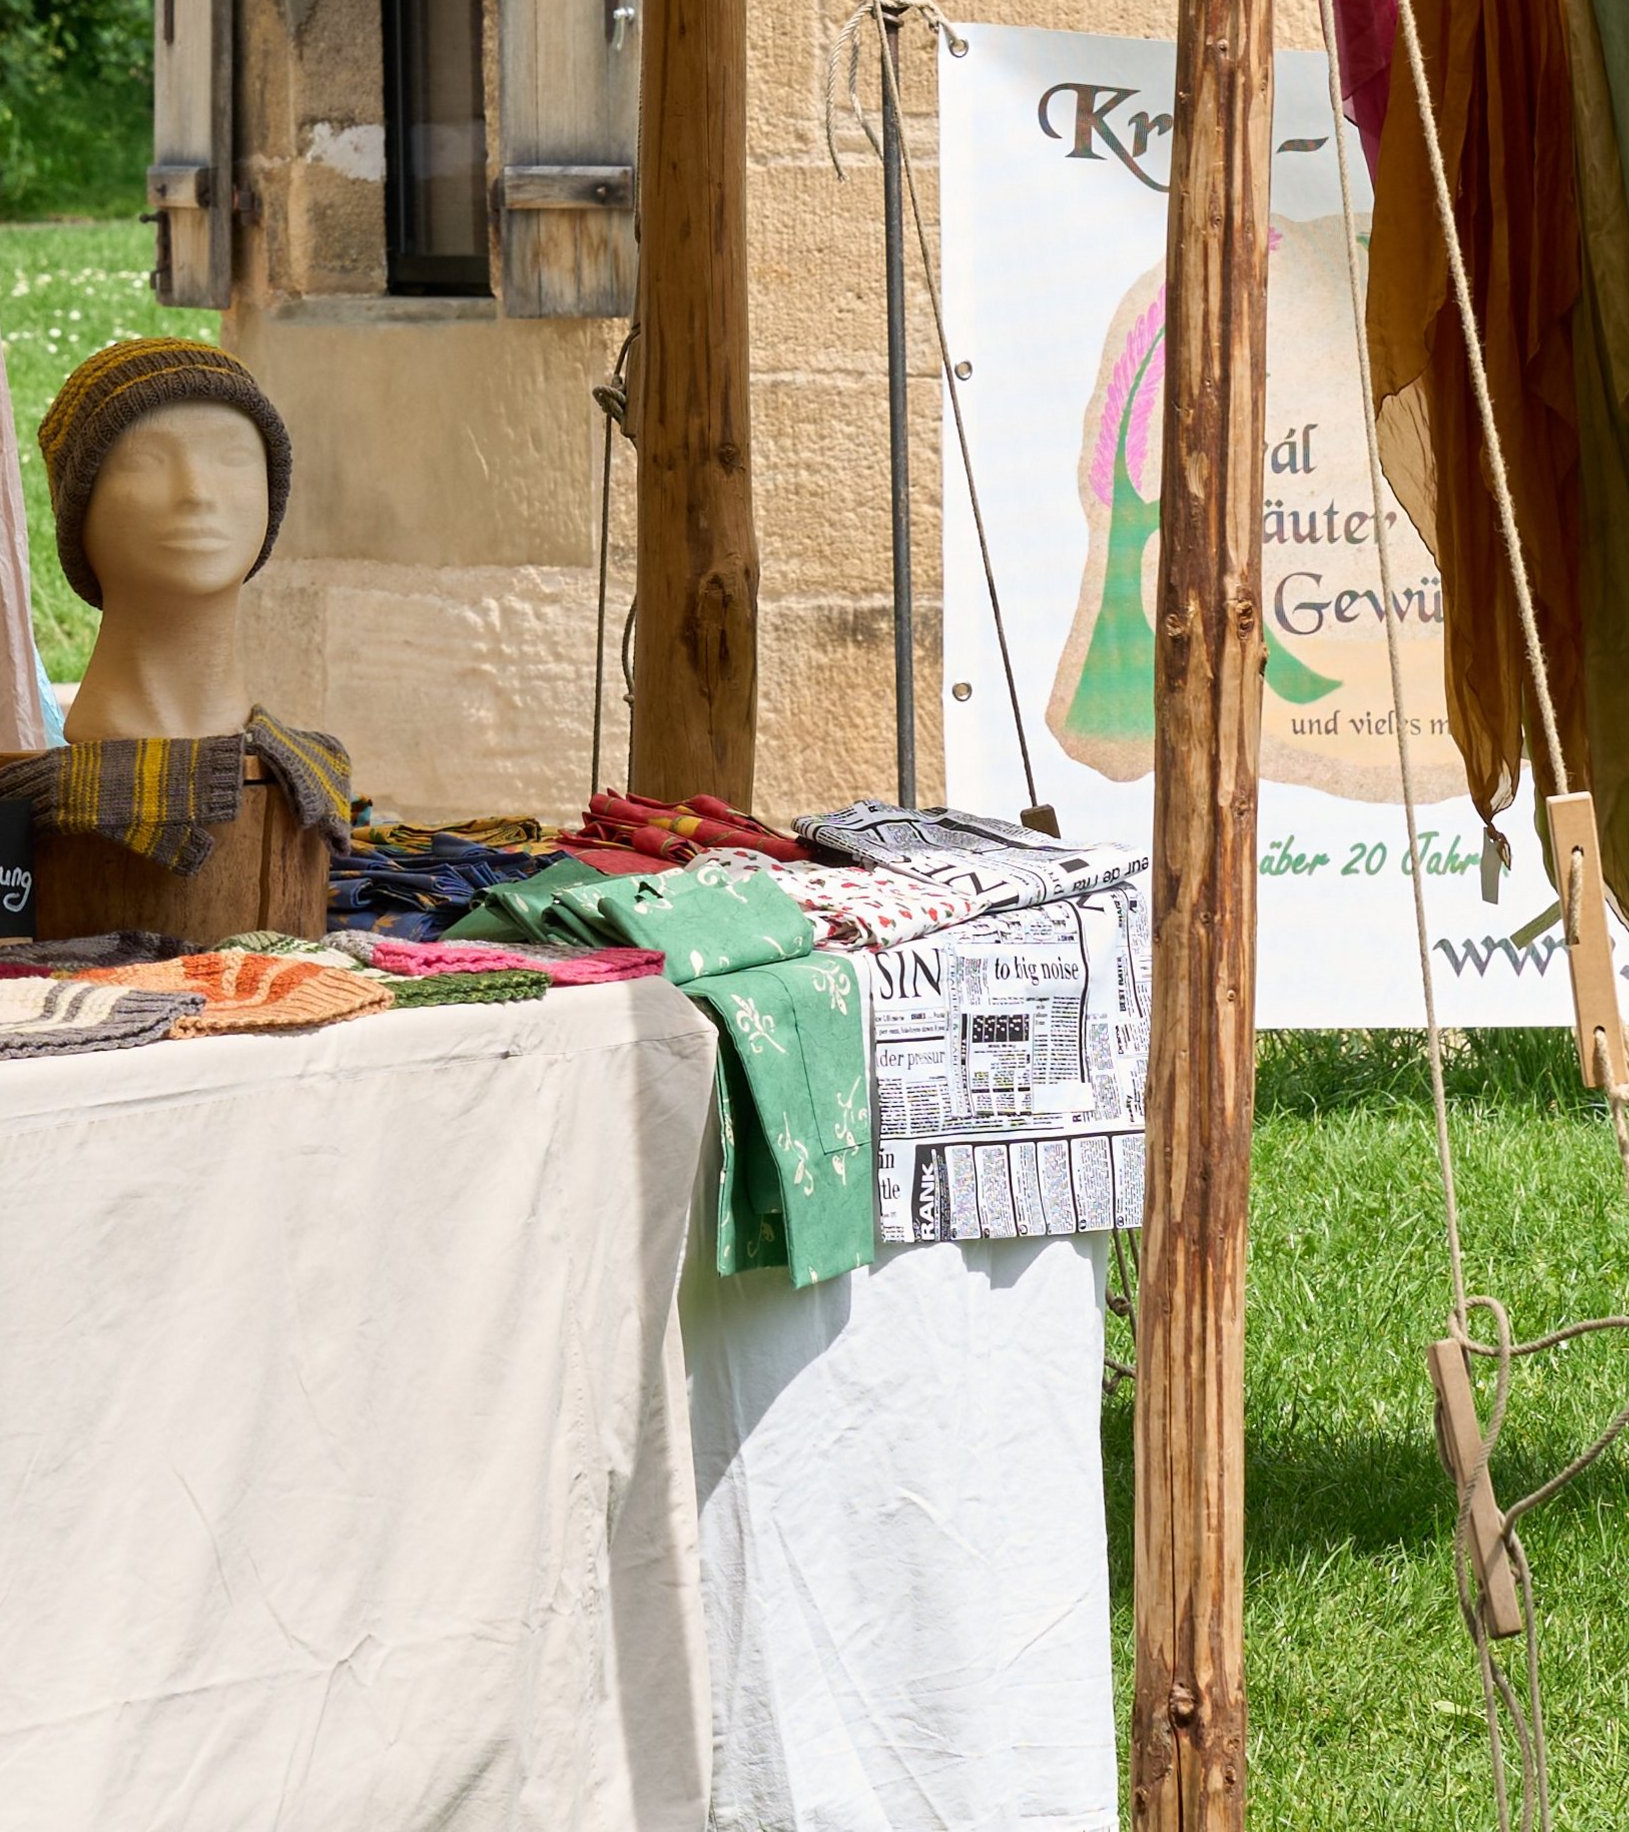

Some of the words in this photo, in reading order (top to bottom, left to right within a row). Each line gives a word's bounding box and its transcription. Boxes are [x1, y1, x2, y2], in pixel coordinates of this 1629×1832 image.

[1038, 82, 1174, 193] Kr
[1262, 423, 1319, 475] ál
[1262, 497, 1397, 545] äuter
[1274, 571, 1444, 635] Gewü
[1291, 710, 1342, 736] und
[1340, 841, 1388, 877] 20
[994, 958, 1010, 981] to
[1014, 955, 1040, 986] big
[1043, 955, 1080, 981] noise
[919, 1163, 935, 1241] RANK
